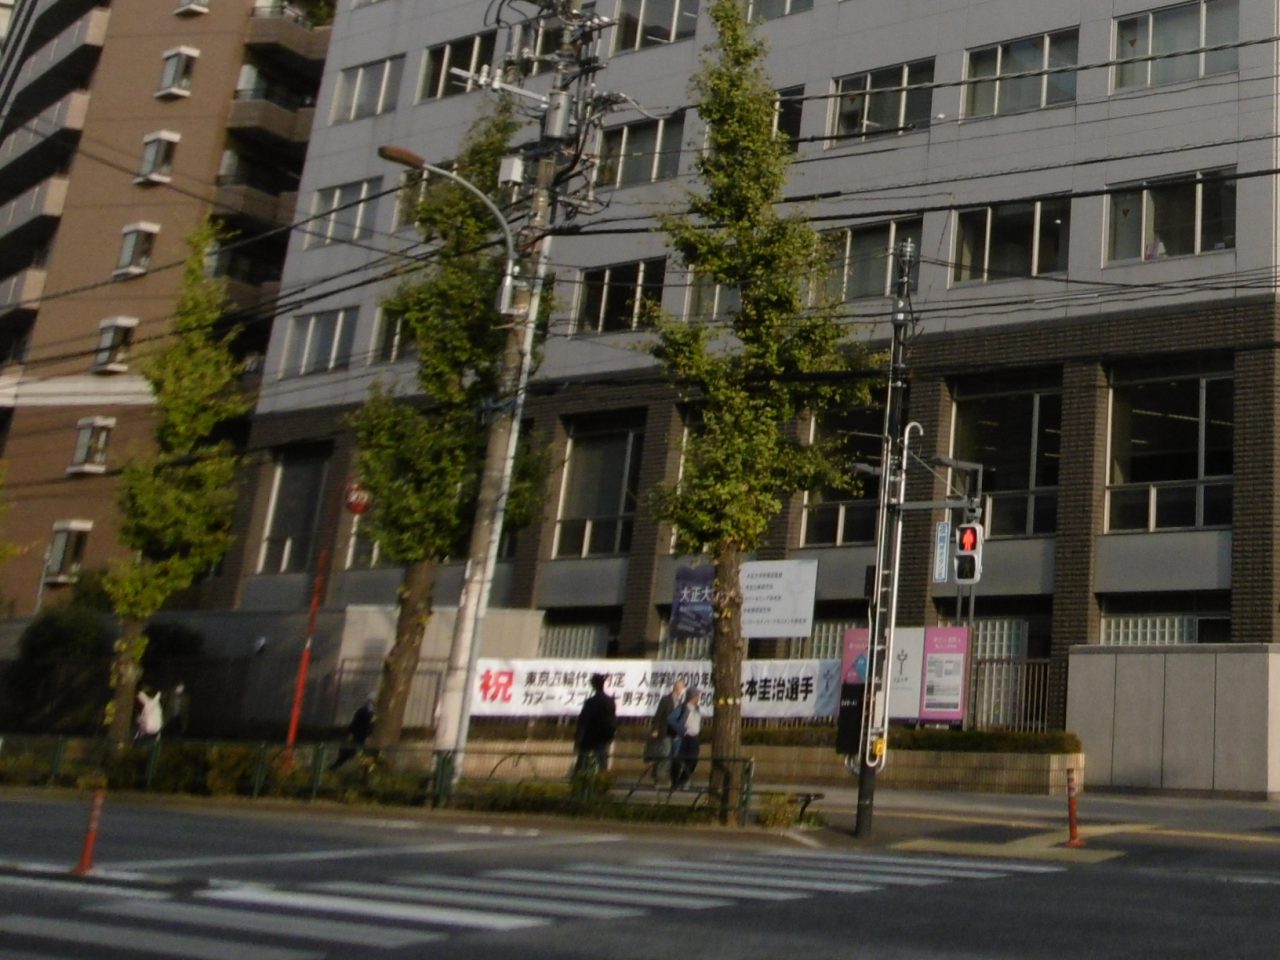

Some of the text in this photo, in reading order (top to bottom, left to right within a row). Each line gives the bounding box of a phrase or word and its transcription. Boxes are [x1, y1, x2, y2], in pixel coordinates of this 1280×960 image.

[480, 669, 515, 703] 祝
[739, 676, 813, 702] 本圭治選手
